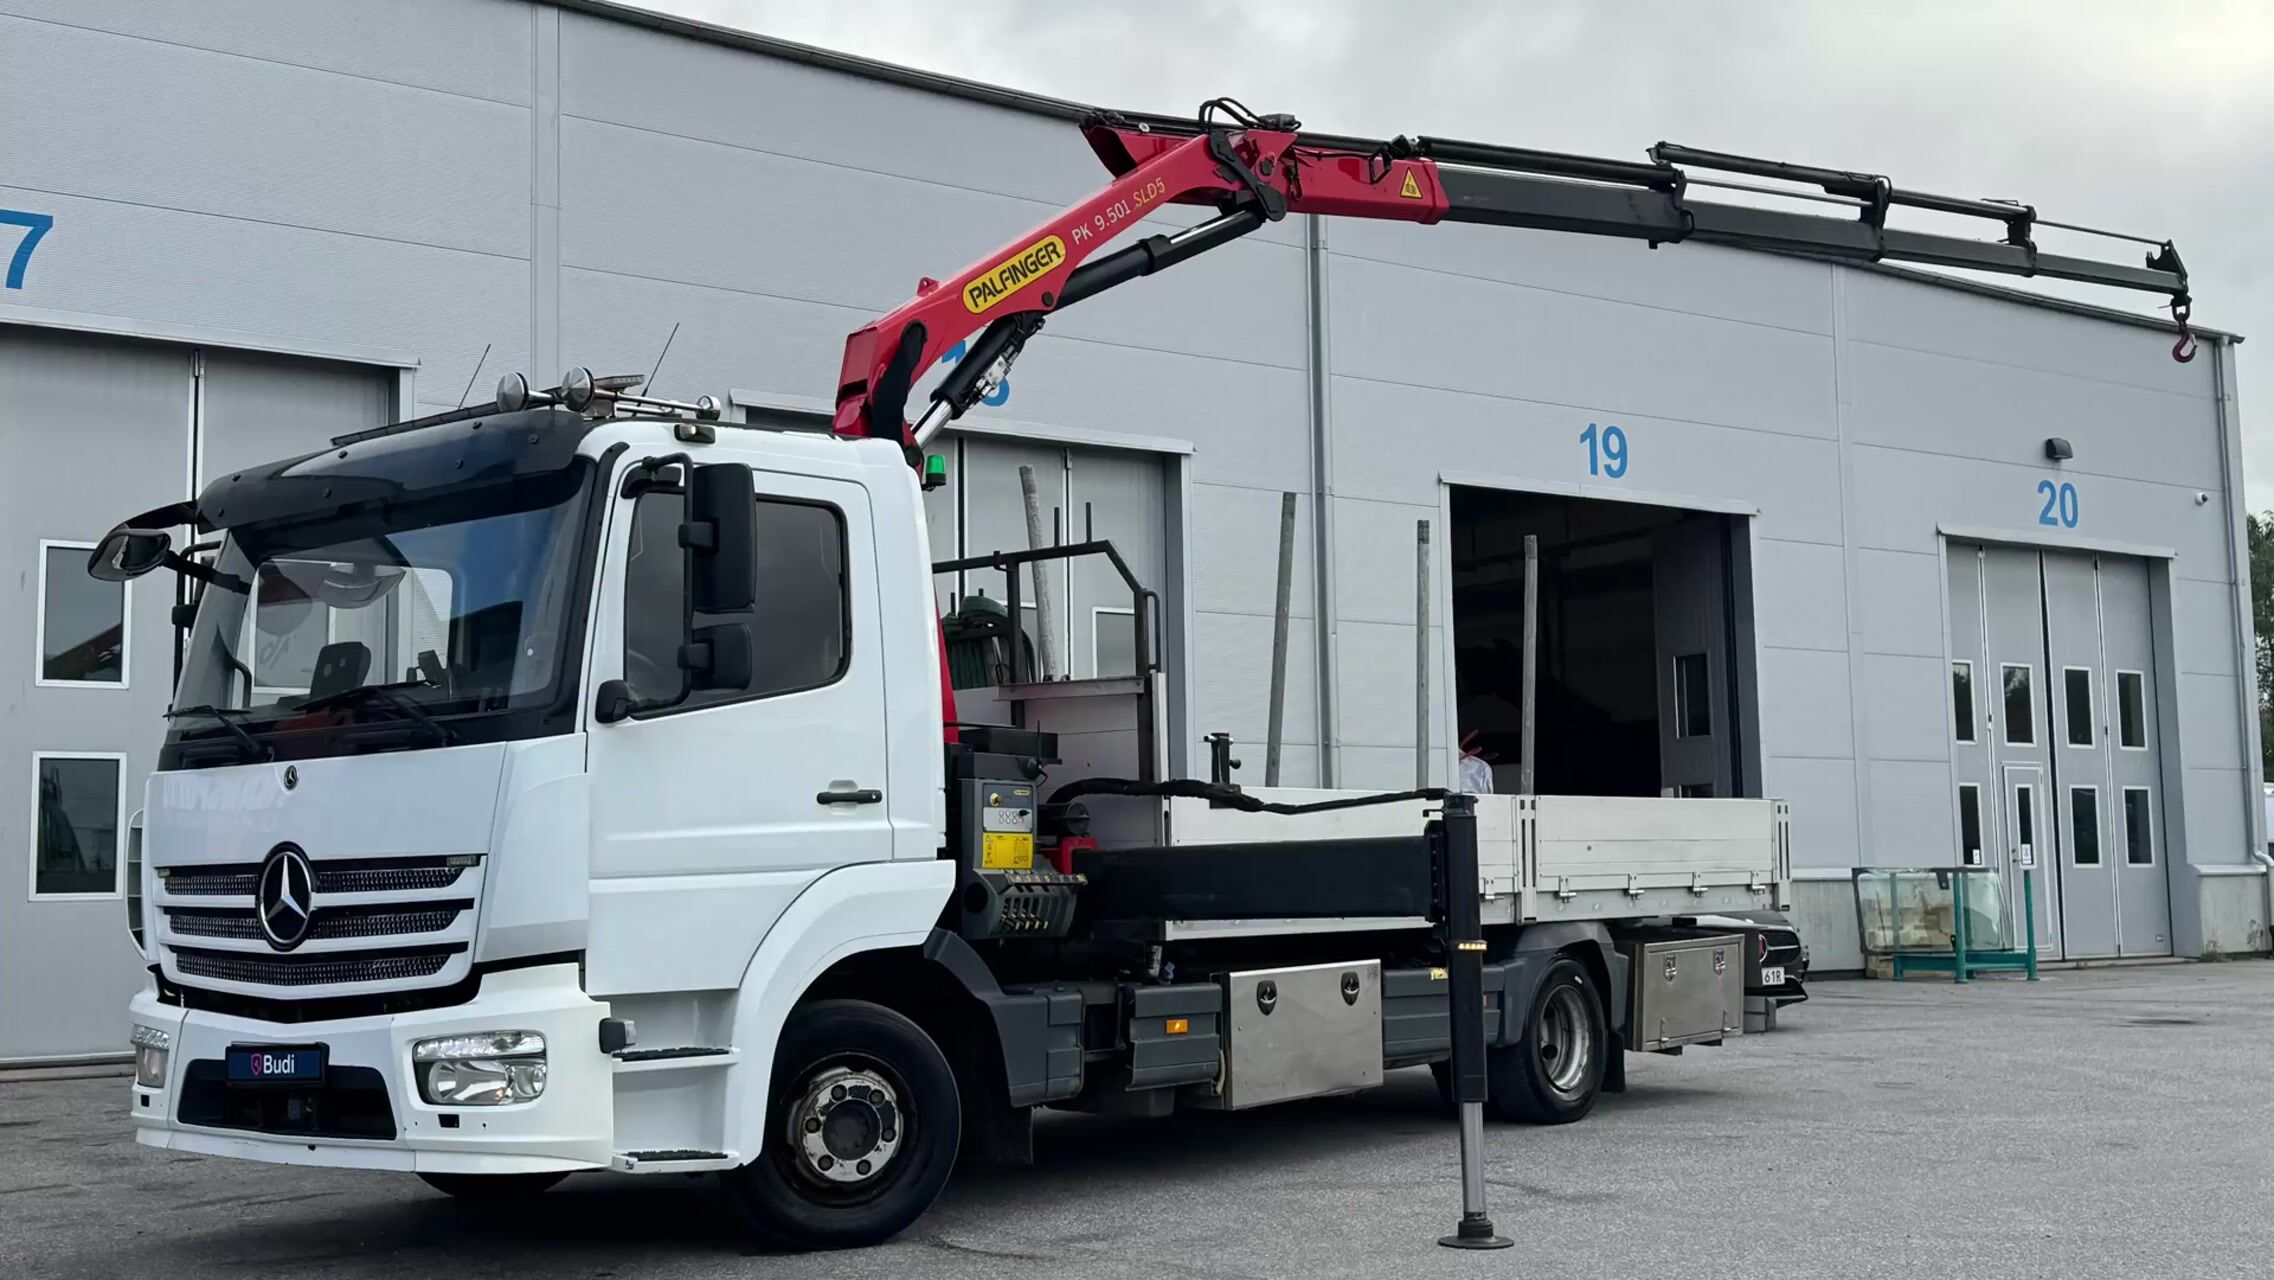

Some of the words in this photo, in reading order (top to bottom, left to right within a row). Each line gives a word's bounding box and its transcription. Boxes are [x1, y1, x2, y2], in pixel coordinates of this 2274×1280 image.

[1071, 224, 1093, 245] PK
[1095, 200, 1132, 231] 9.501
[1133, 177, 1166, 208] SLD5
[0, 209, 54, 289] 7
[968, 241, 1062, 308] PALFINGER
[1580, 423, 1628, 478] 19
[2038, 480, 2079, 528] 20
[1764, 970, 1782, 984] 61R
[263, 1053, 295, 1074] Budi
